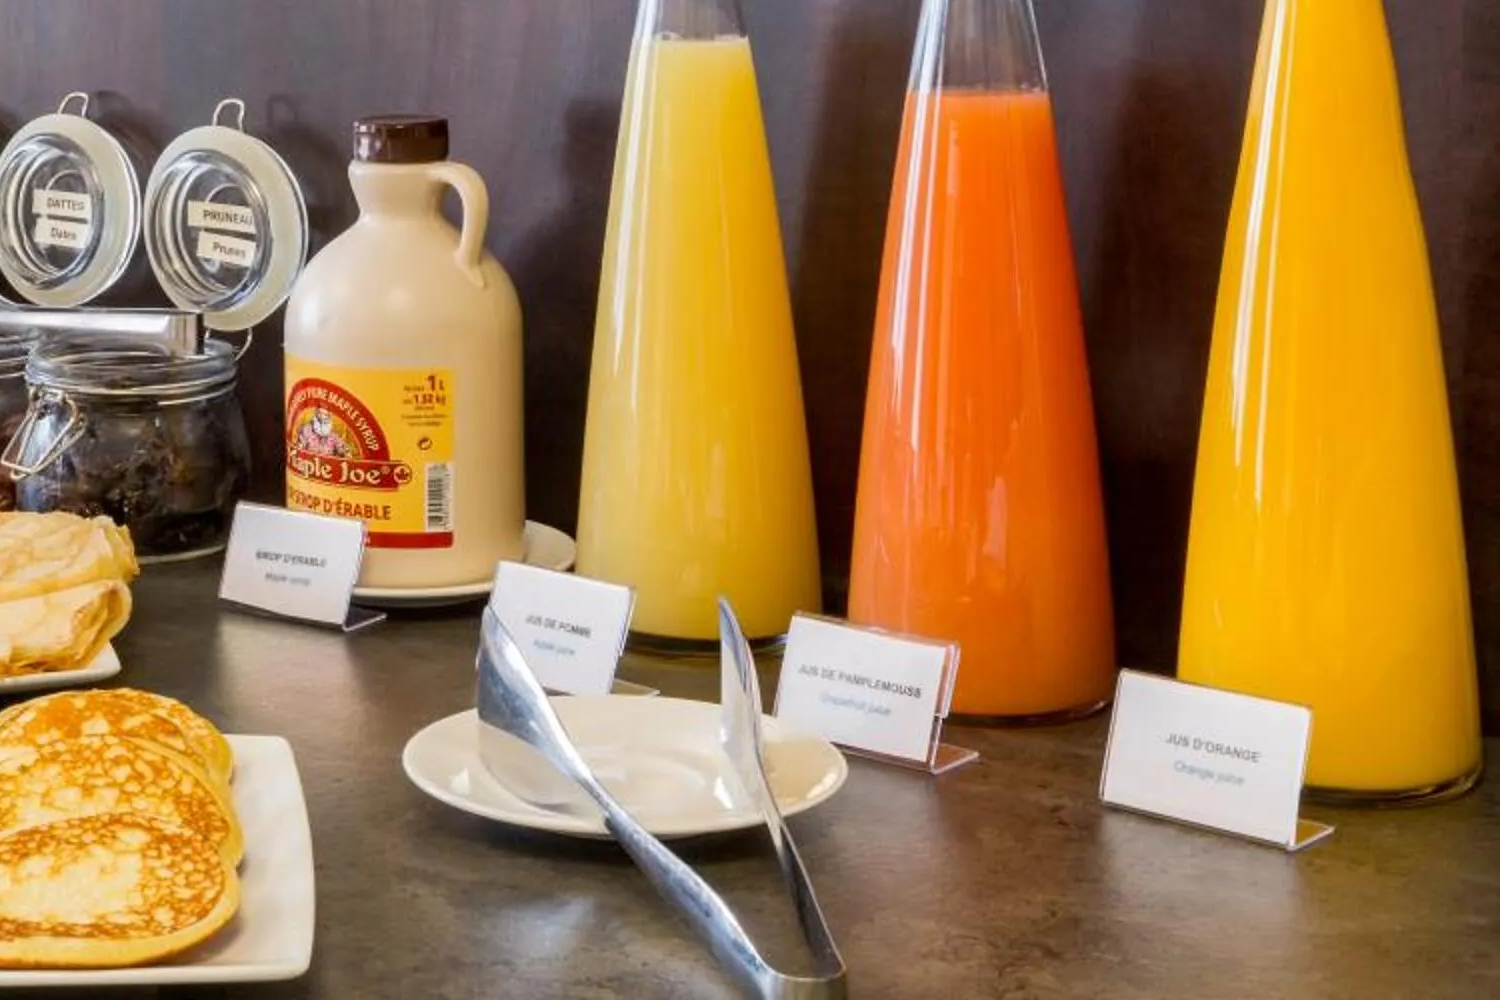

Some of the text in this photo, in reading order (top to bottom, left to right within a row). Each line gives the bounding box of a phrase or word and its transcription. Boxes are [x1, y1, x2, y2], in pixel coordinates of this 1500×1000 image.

[46, 197, 85, 212] DATTES
[427, 375, 436, 392] 1
[355, 417, 380, 451] SYRUP
[338, 460, 382, 485] Joe
[820, 667, 836, 680] DE
[1165, 733, 1262, 764] JUS D'ORANGE
